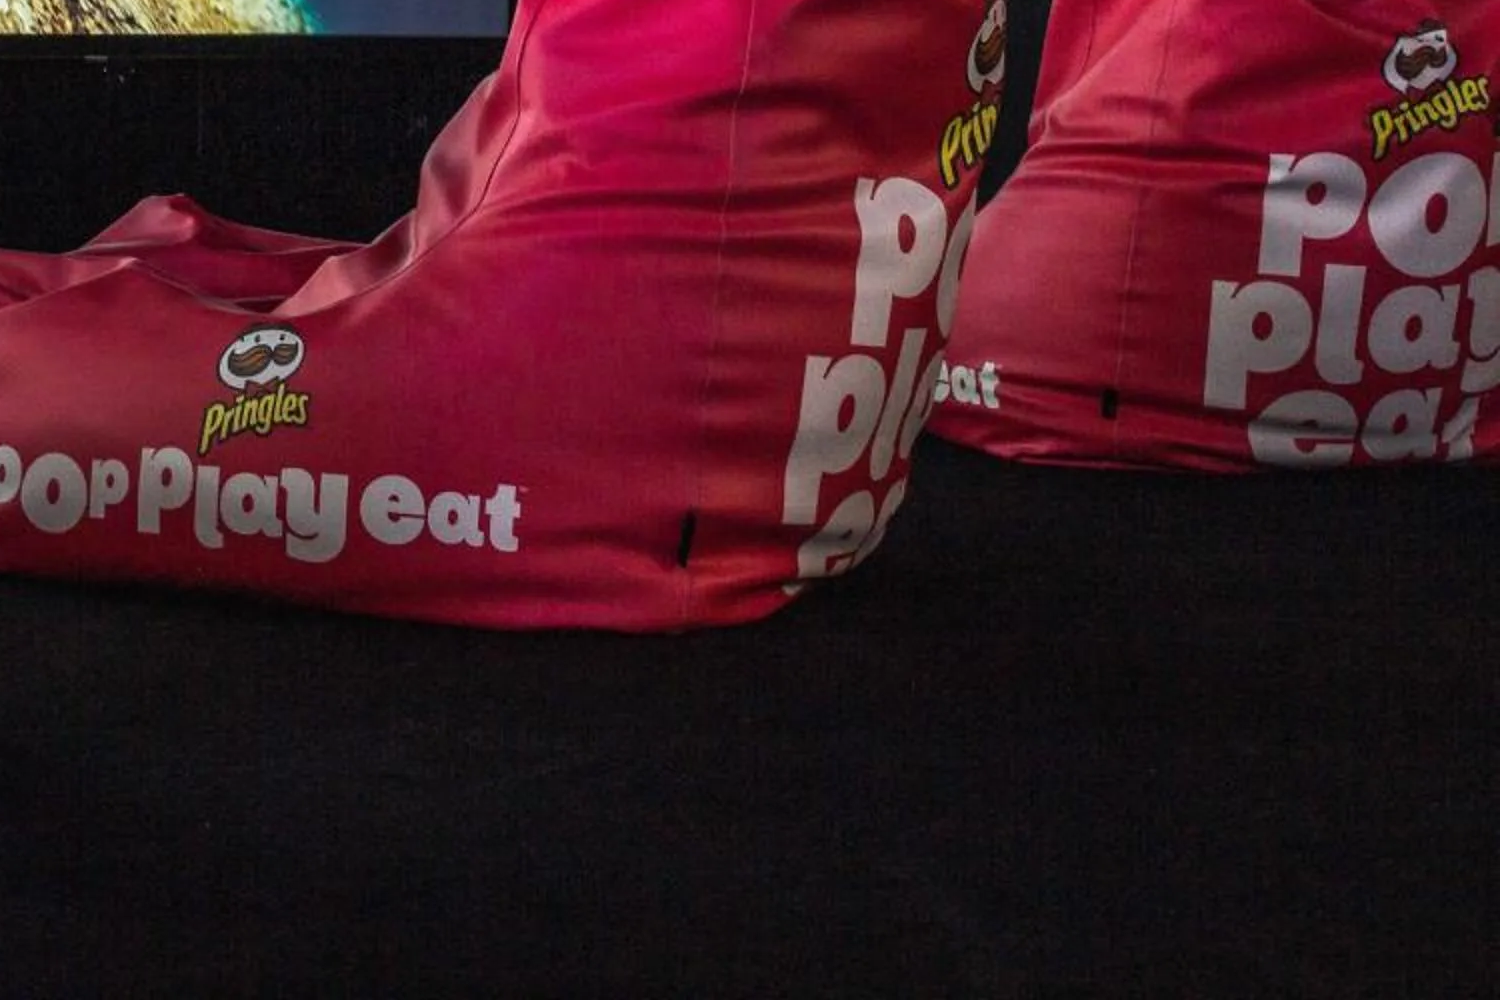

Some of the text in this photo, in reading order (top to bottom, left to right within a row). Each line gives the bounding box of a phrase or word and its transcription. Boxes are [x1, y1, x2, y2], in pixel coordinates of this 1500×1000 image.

[1372, 76, 1490, 160] Pringles
[1258, 151, 1500, 278] po
[199, 384, 309, 454] Pringles
[360, 474, 521, 553] eat
